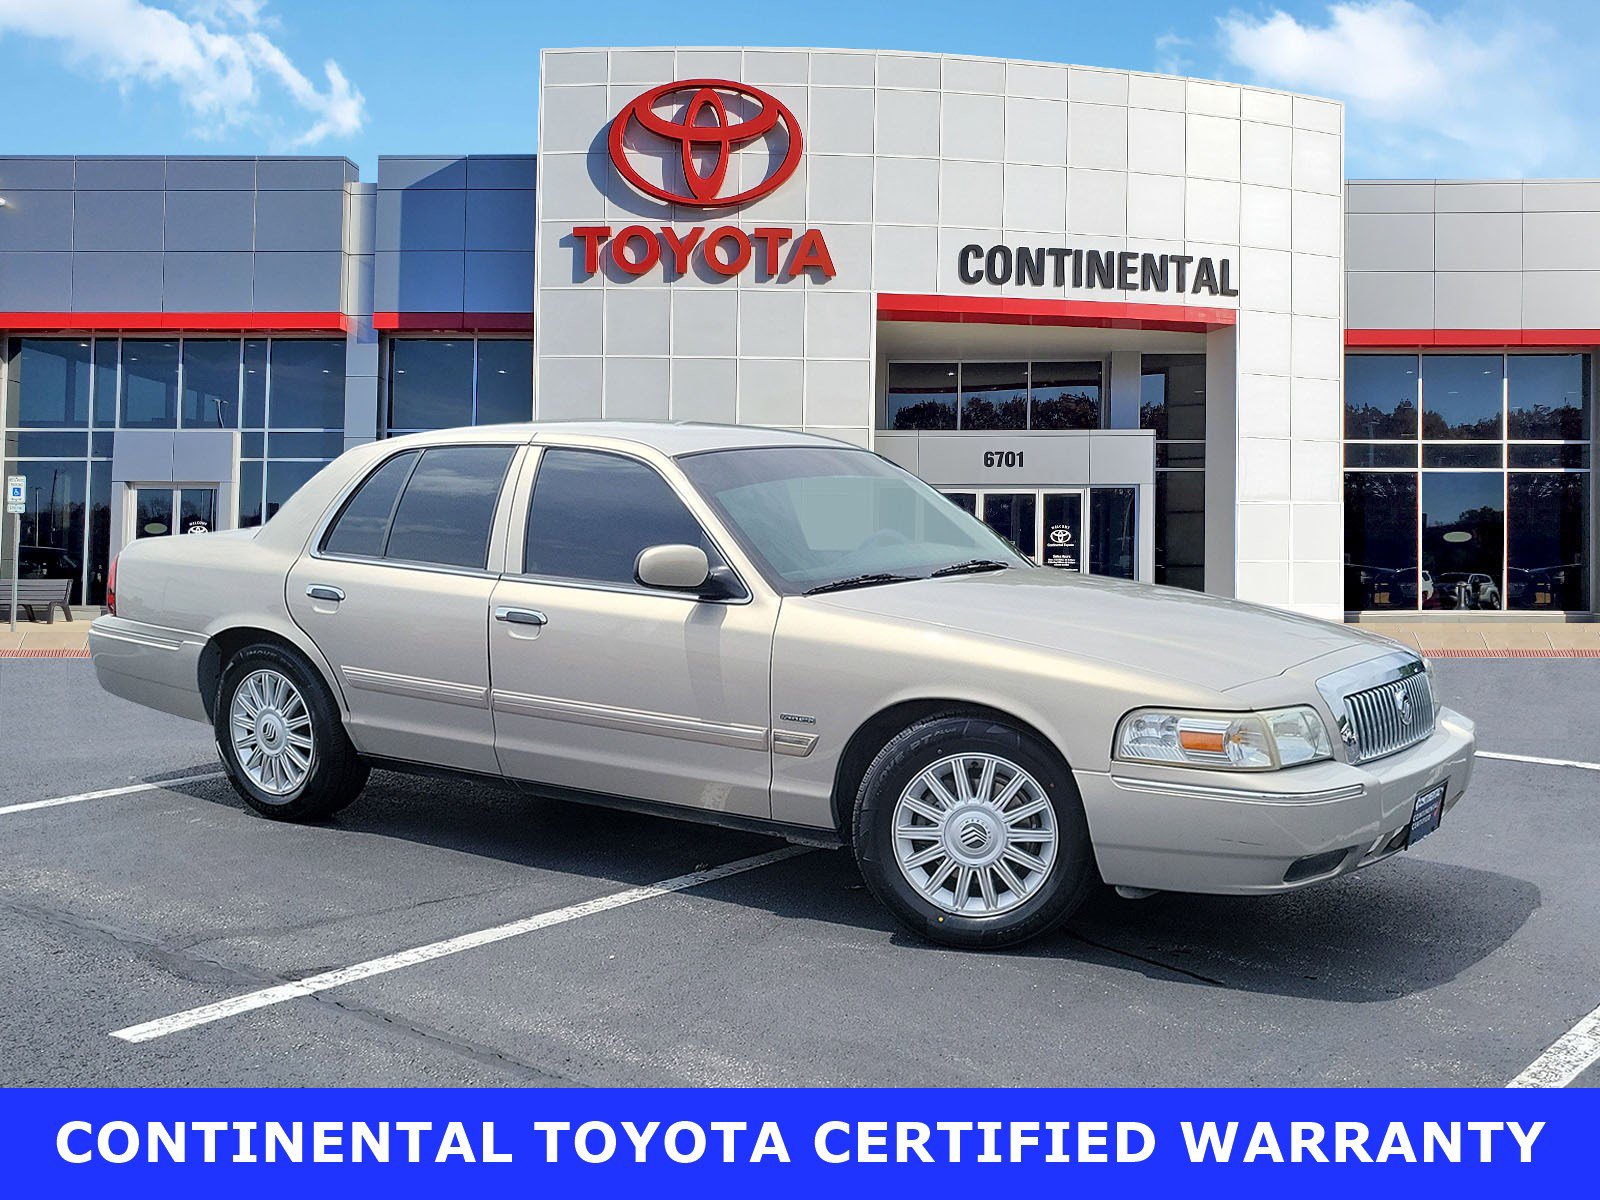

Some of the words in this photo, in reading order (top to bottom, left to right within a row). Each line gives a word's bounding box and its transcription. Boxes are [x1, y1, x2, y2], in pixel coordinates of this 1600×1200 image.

[573, 225, 837, 277] TOYOTA
[958, 243, 1239, 297] CONTINENTAL
[983, 451, 1024, 468] 6701
